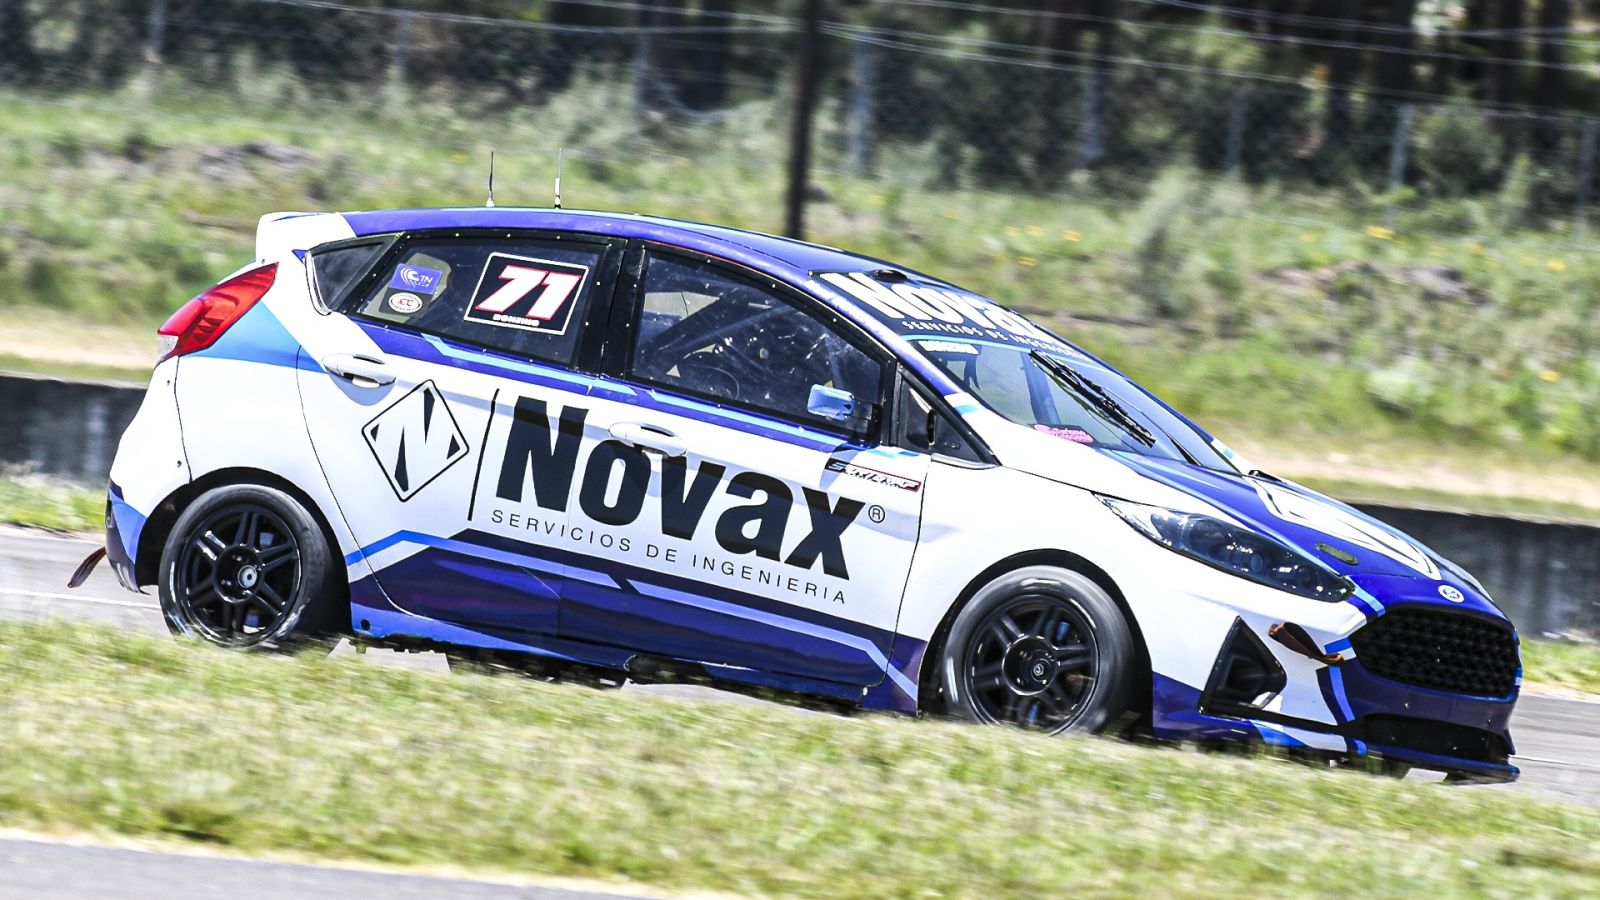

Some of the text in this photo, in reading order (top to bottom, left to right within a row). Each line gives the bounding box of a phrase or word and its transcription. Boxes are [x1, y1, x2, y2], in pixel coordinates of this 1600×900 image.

[475, 264, 582, 320] 71
[902, 321, 983, 337] SERVICIOS
[985, 330, 1009, 341] DE
[495, 396, 866, 580] Novax
[491, 509, 846, 605] SERVICIOS DE INGENIERIA
